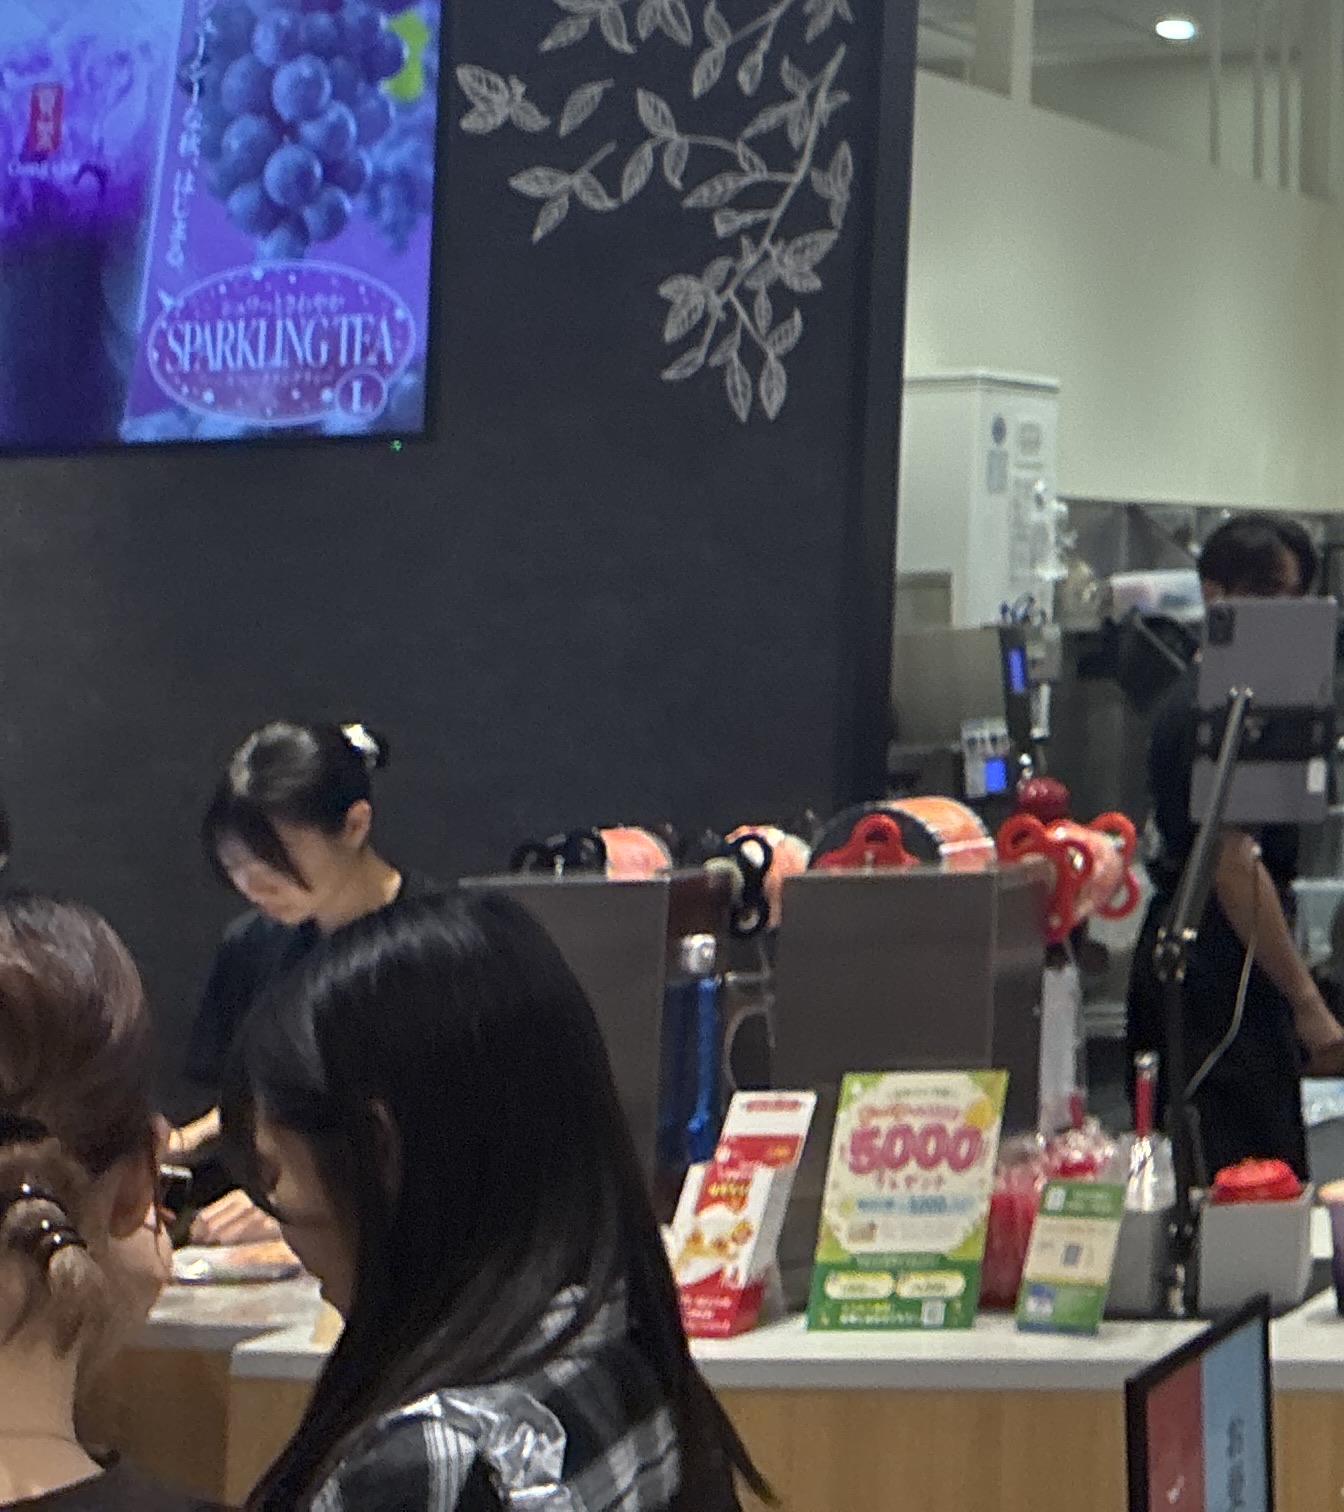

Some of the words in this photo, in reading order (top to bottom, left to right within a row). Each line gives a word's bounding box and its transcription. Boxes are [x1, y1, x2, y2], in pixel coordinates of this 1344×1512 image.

[166, 316, 330, 372] SPARKLING
[336, 312, 394, 368] TEA
[849, 1123, 982, 1174] 5000
